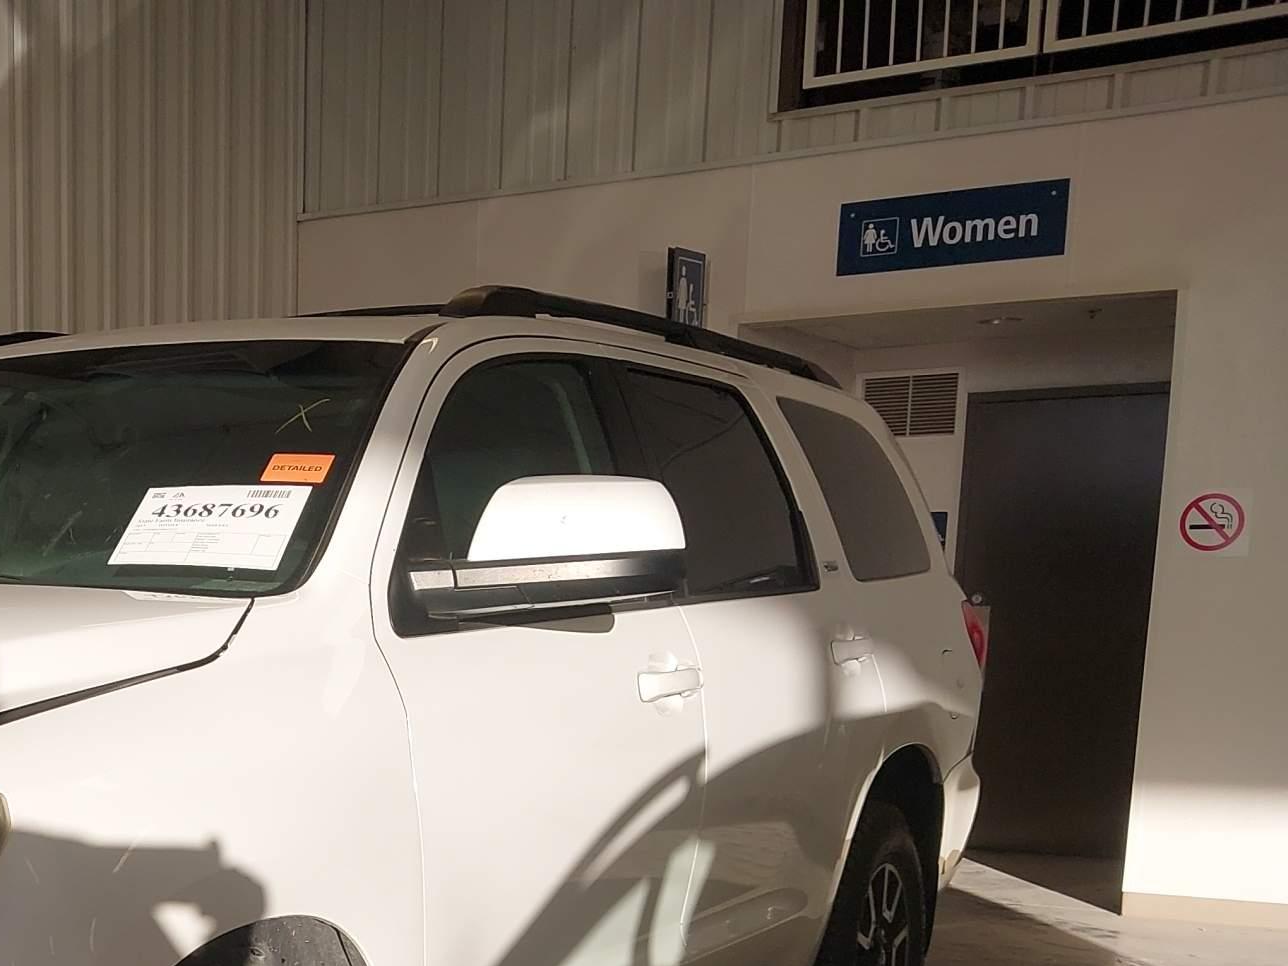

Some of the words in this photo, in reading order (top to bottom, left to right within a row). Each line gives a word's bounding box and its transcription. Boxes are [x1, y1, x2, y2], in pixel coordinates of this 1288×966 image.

[910, 213, 1039, 248] Women
[272, 464, 322, 472] DETAILED
[151, 503, 284, 519] 43687696
